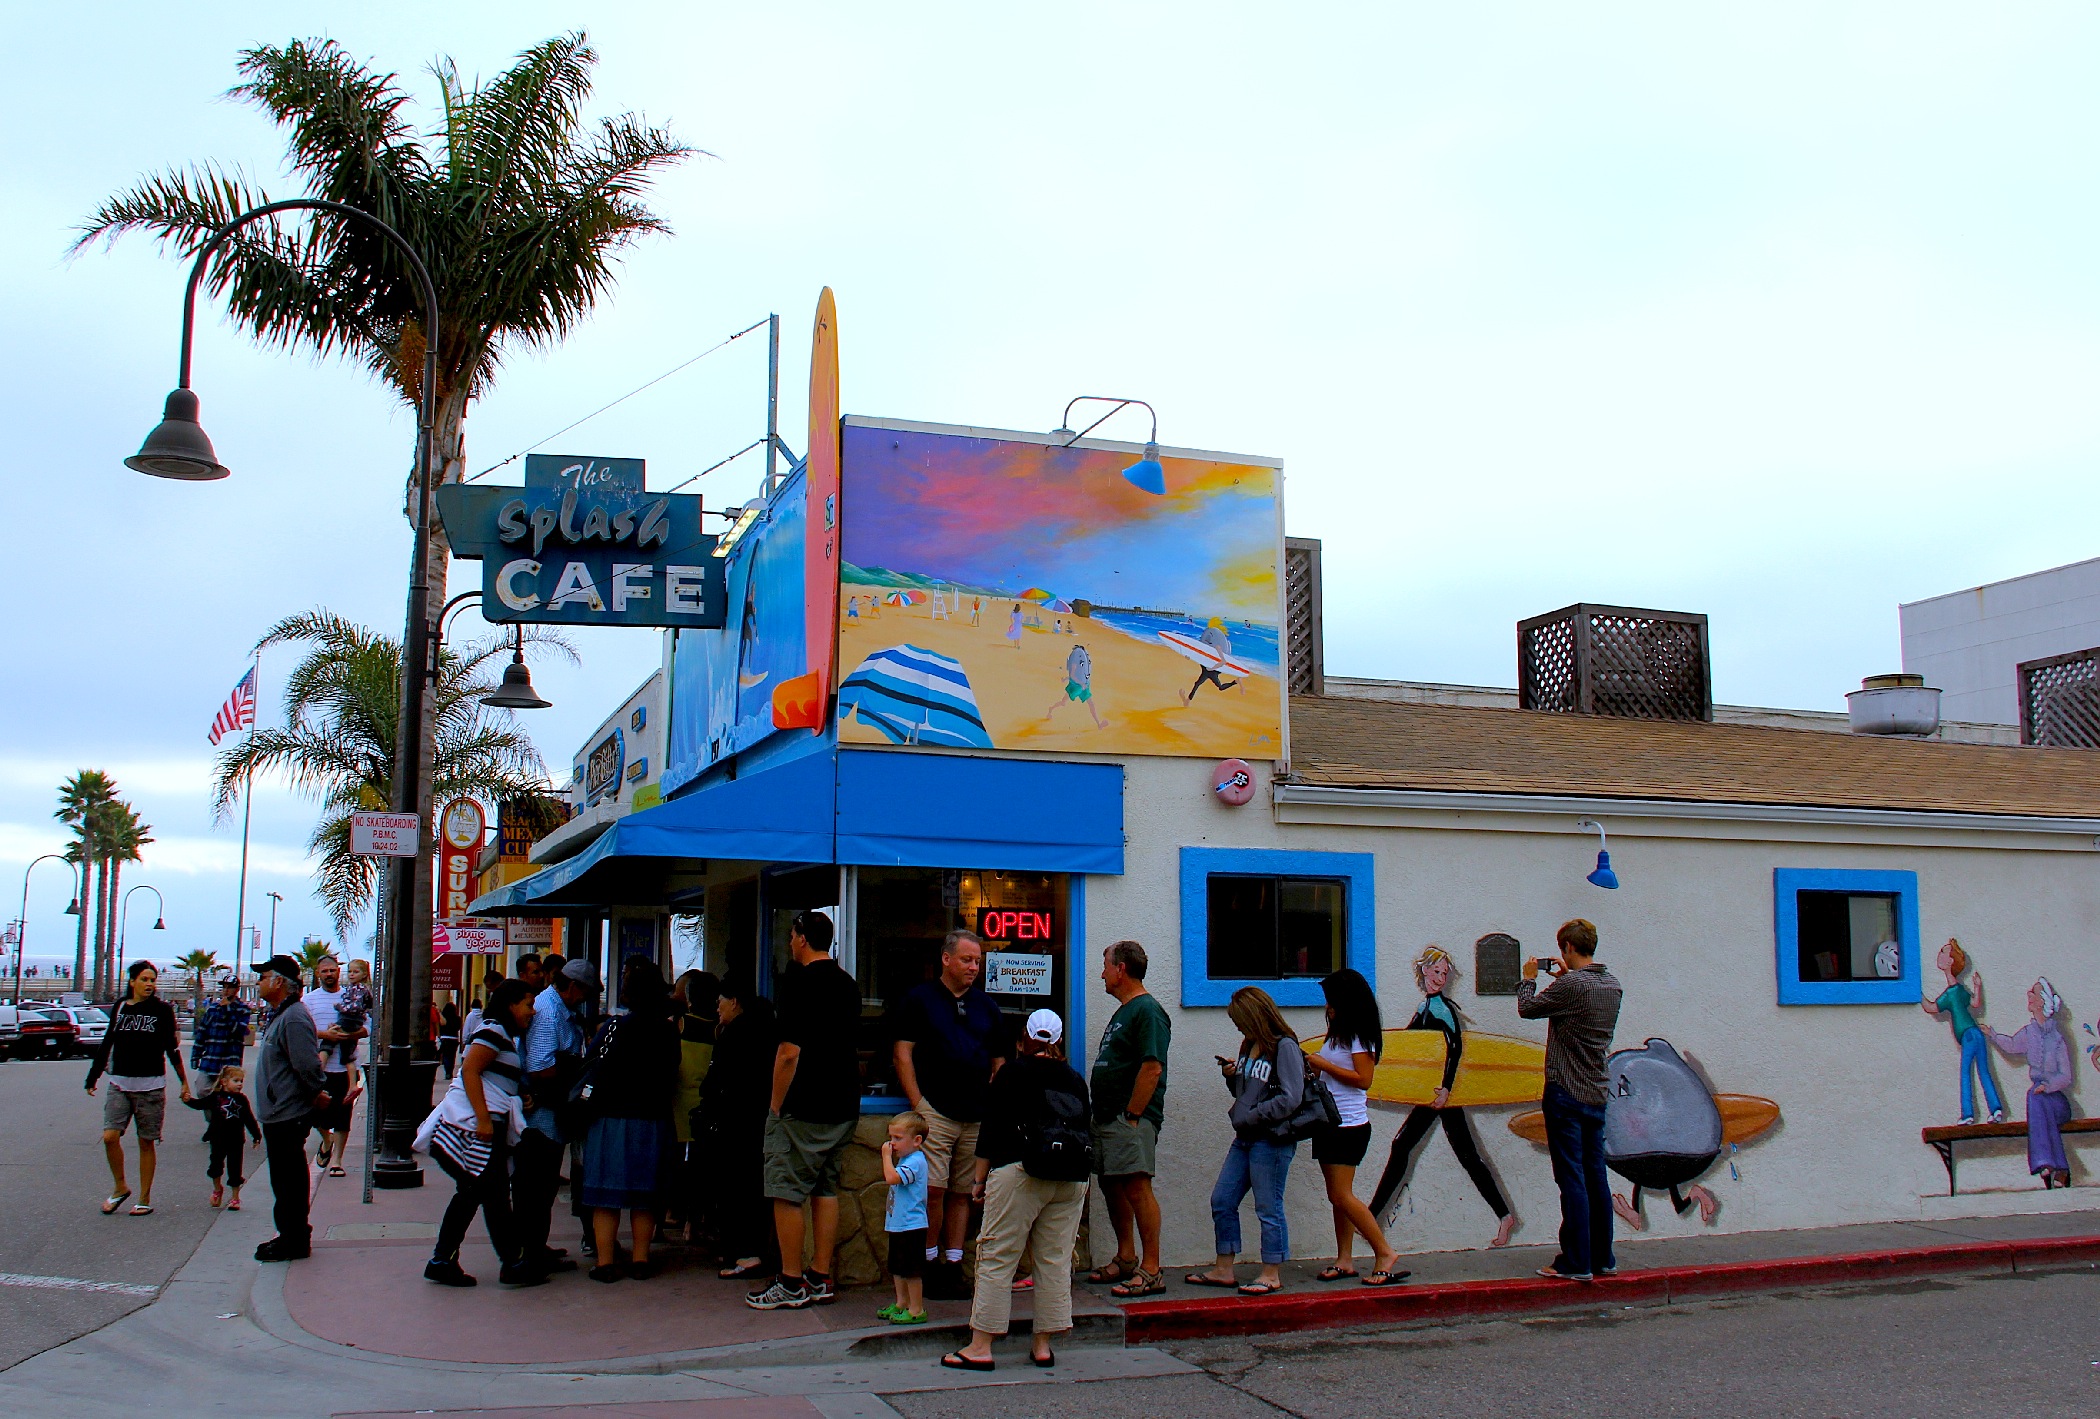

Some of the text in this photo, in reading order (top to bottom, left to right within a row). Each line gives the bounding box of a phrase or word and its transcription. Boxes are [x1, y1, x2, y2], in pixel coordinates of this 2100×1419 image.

[561, 460, 613, 490] The
[495, 558, 705, 615] CAFE
[355, 816, 417, 829] NO SKATEBOARDING
[372, 829, 398, 840] P.B.M.C.
[984, 911, 1051, 939] OPEN
[455, 929, 486, 940] pismo
[466, 938, 501, 952] yogurt
[1020, 959, 1046, 967] SERVING
[1000, 967, 1047, 977] BREAKFAST
[1011, 977, 1037, 986] DAILY
